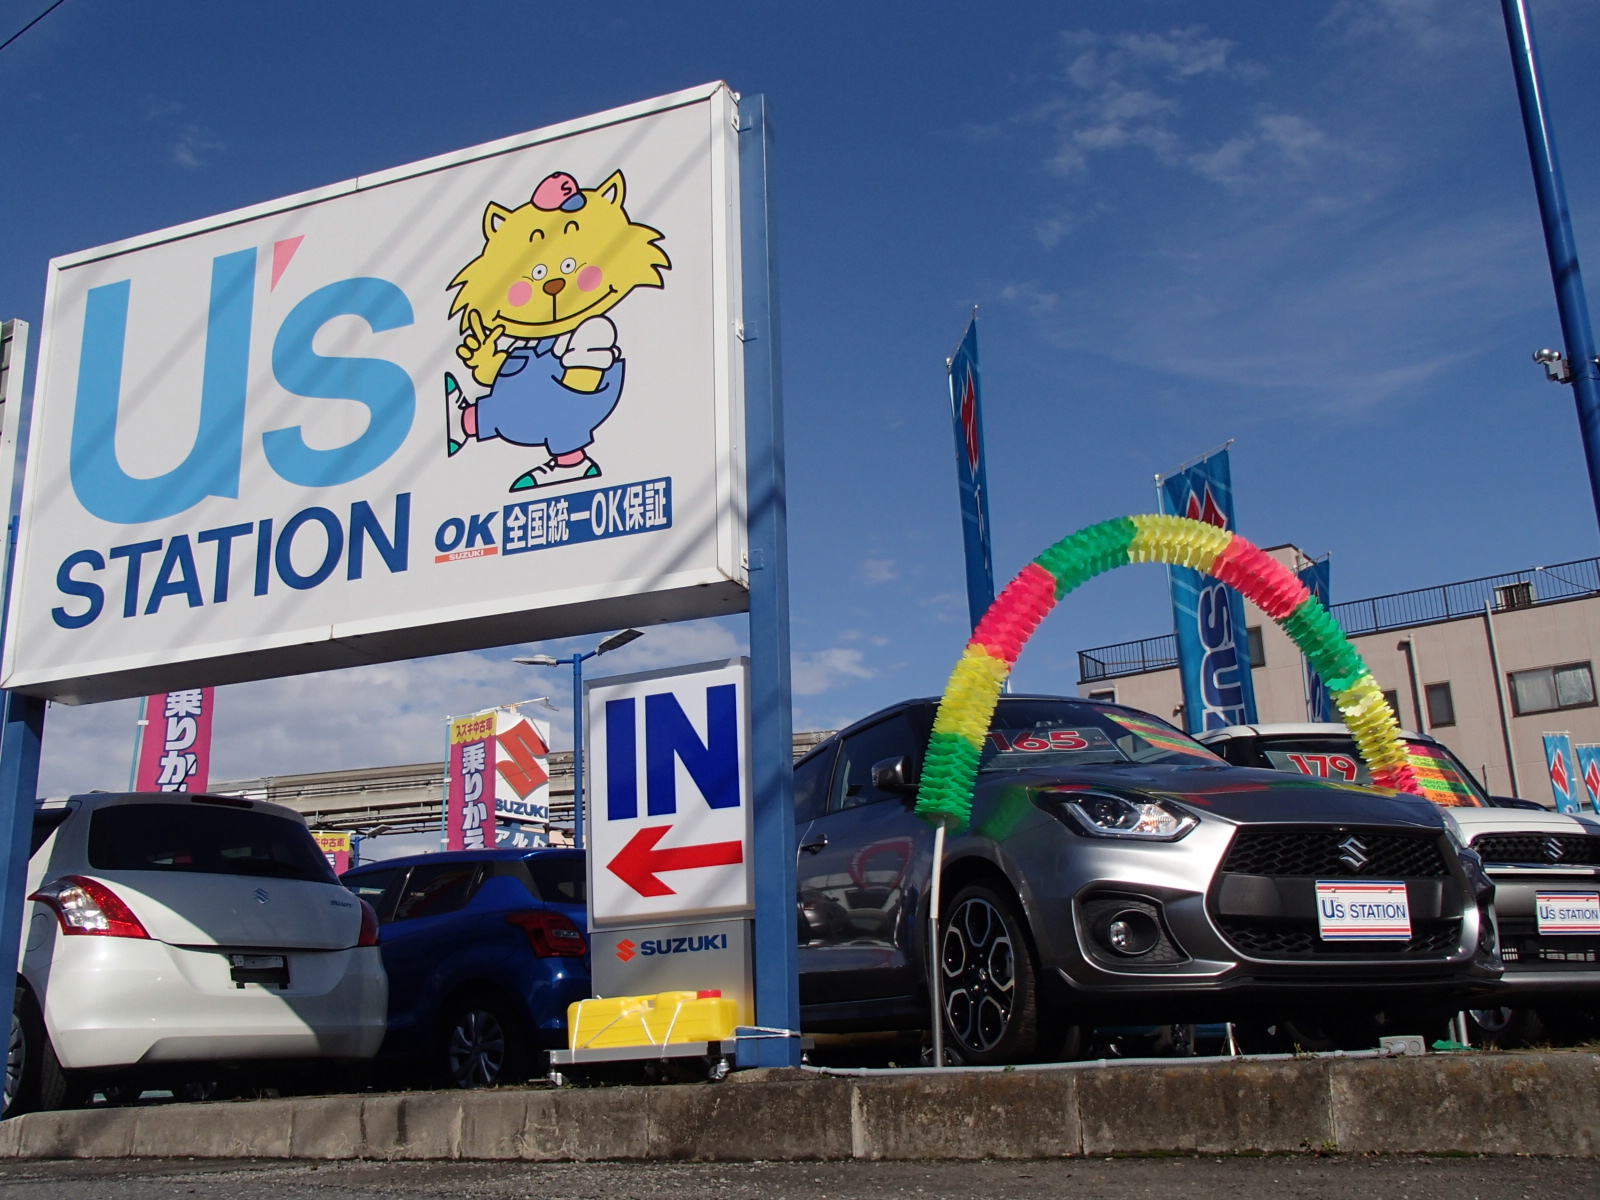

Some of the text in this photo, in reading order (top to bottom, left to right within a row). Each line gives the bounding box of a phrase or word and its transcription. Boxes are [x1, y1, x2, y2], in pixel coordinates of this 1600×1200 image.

[505, 480, 668, 550] 全国統一OK保証
[434, 510, 500, 553] OK
[51, 492, 411, 630] STATION
[448, 549, 485, 561] SUZUKI
[455, 717, 493, 738] スズキ中古車
[606, 683, 741, 821] IN
[985, 730, 1088, 752] 165
[1287, 754, 1357, 782] 179
[495, 798, 549, 819] SUZUKI
[1349, 904, 1406, 919] STATION
[1558, 909, 1599, 920] STATION
[640, 933, 727, 956] SUZUKI
